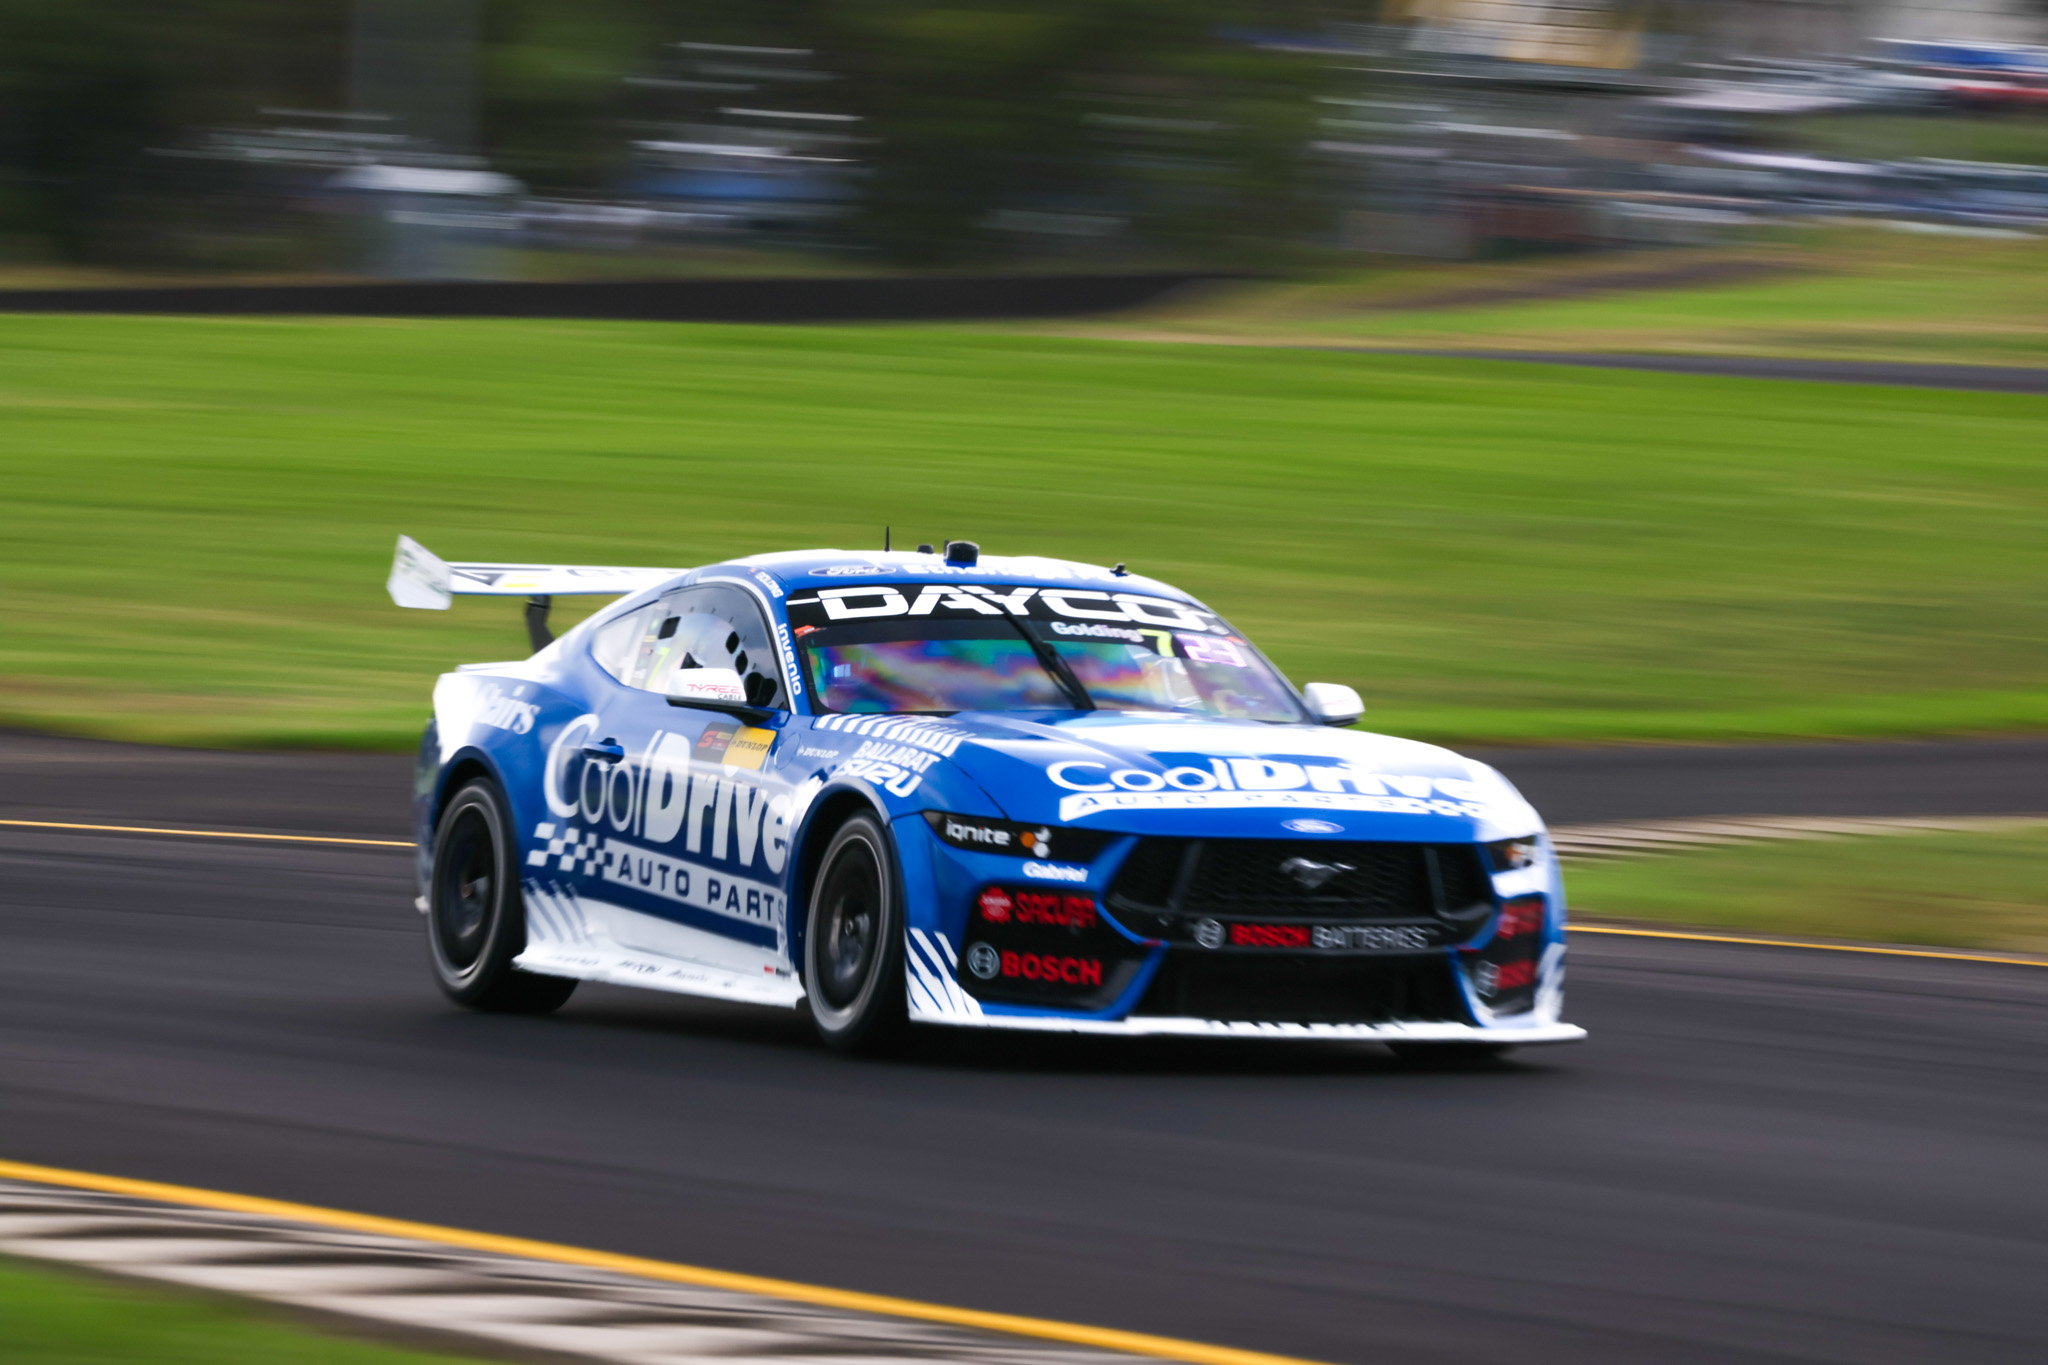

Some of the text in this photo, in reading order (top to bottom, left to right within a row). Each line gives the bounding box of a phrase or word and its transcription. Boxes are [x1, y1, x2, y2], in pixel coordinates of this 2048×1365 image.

[817, 585, 1216, 631] DAYCO
[1050, 621, 1144, 642] Golding
[1138, 628, 1176, 657] 7
[777, 623, 802, 695] invenio
[736, 740, 769, 752] DUNLOP
[803, 746, 840, 759] DUNLOP
[852, 740, 942, 774] BALLARAT
[543, 713, 792, 874] CoolDrive
[828, 758, 924, 798] ISUZU
[1046, 757, 1487, 803] CoolDrive
[946, 820, 1011, 846] ignite
[617, 852, 785, 926] AUTO PARTS
[1002, 950, 1103, 986] BOSCH
